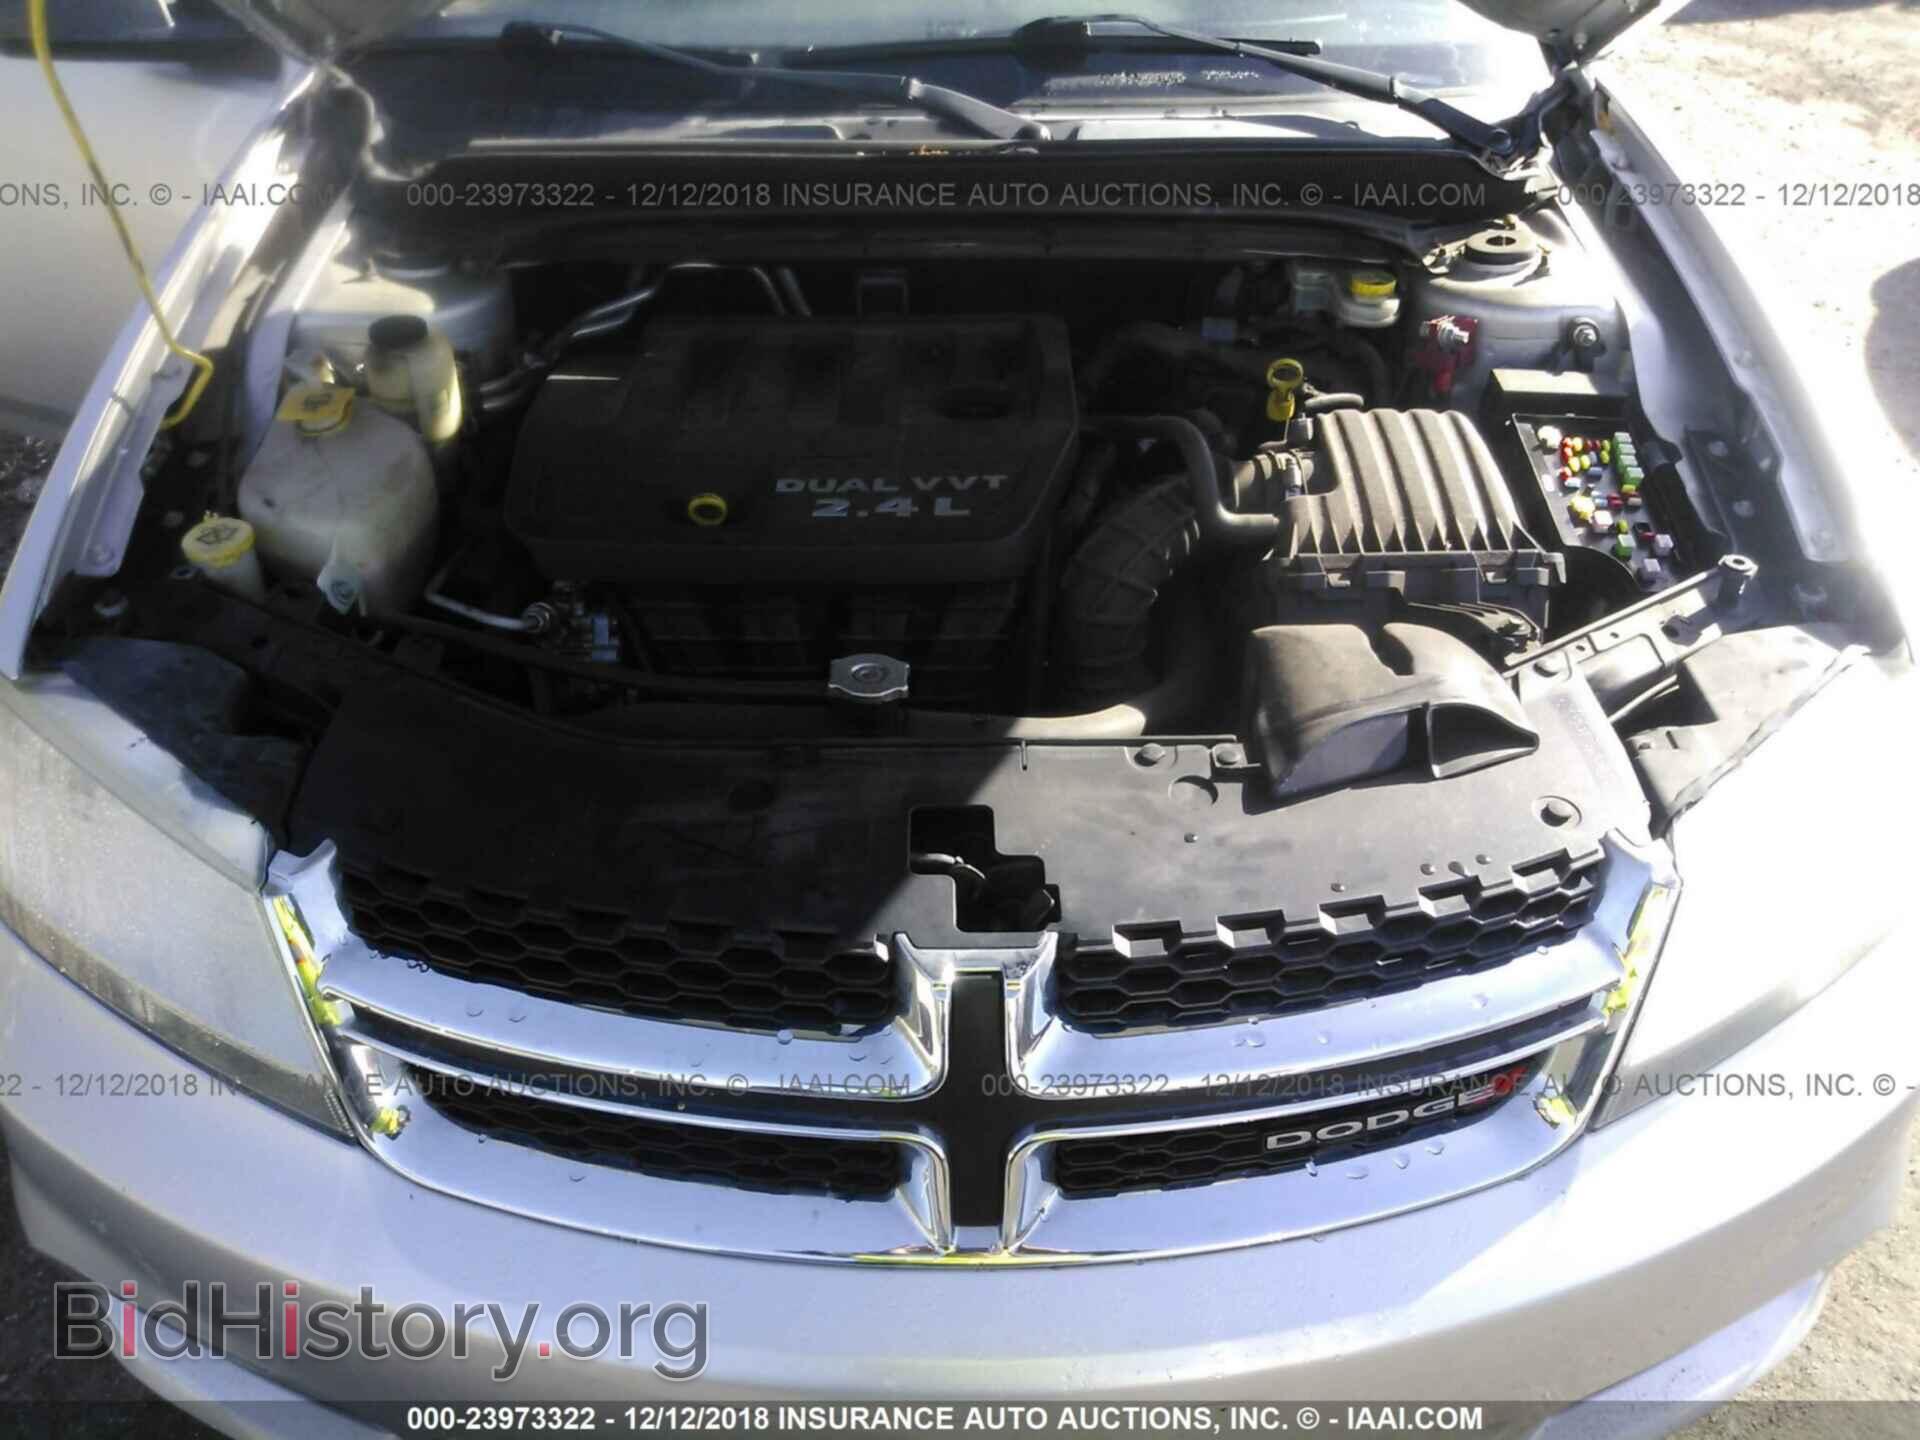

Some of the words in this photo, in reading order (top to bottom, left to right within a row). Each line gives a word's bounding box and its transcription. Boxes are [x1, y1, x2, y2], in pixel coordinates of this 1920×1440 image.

[775, 477, 899, 493] DUAL
[911, 474, 1009, 491] VVT
[1266, 1081, 1495, 1150] DODGE
